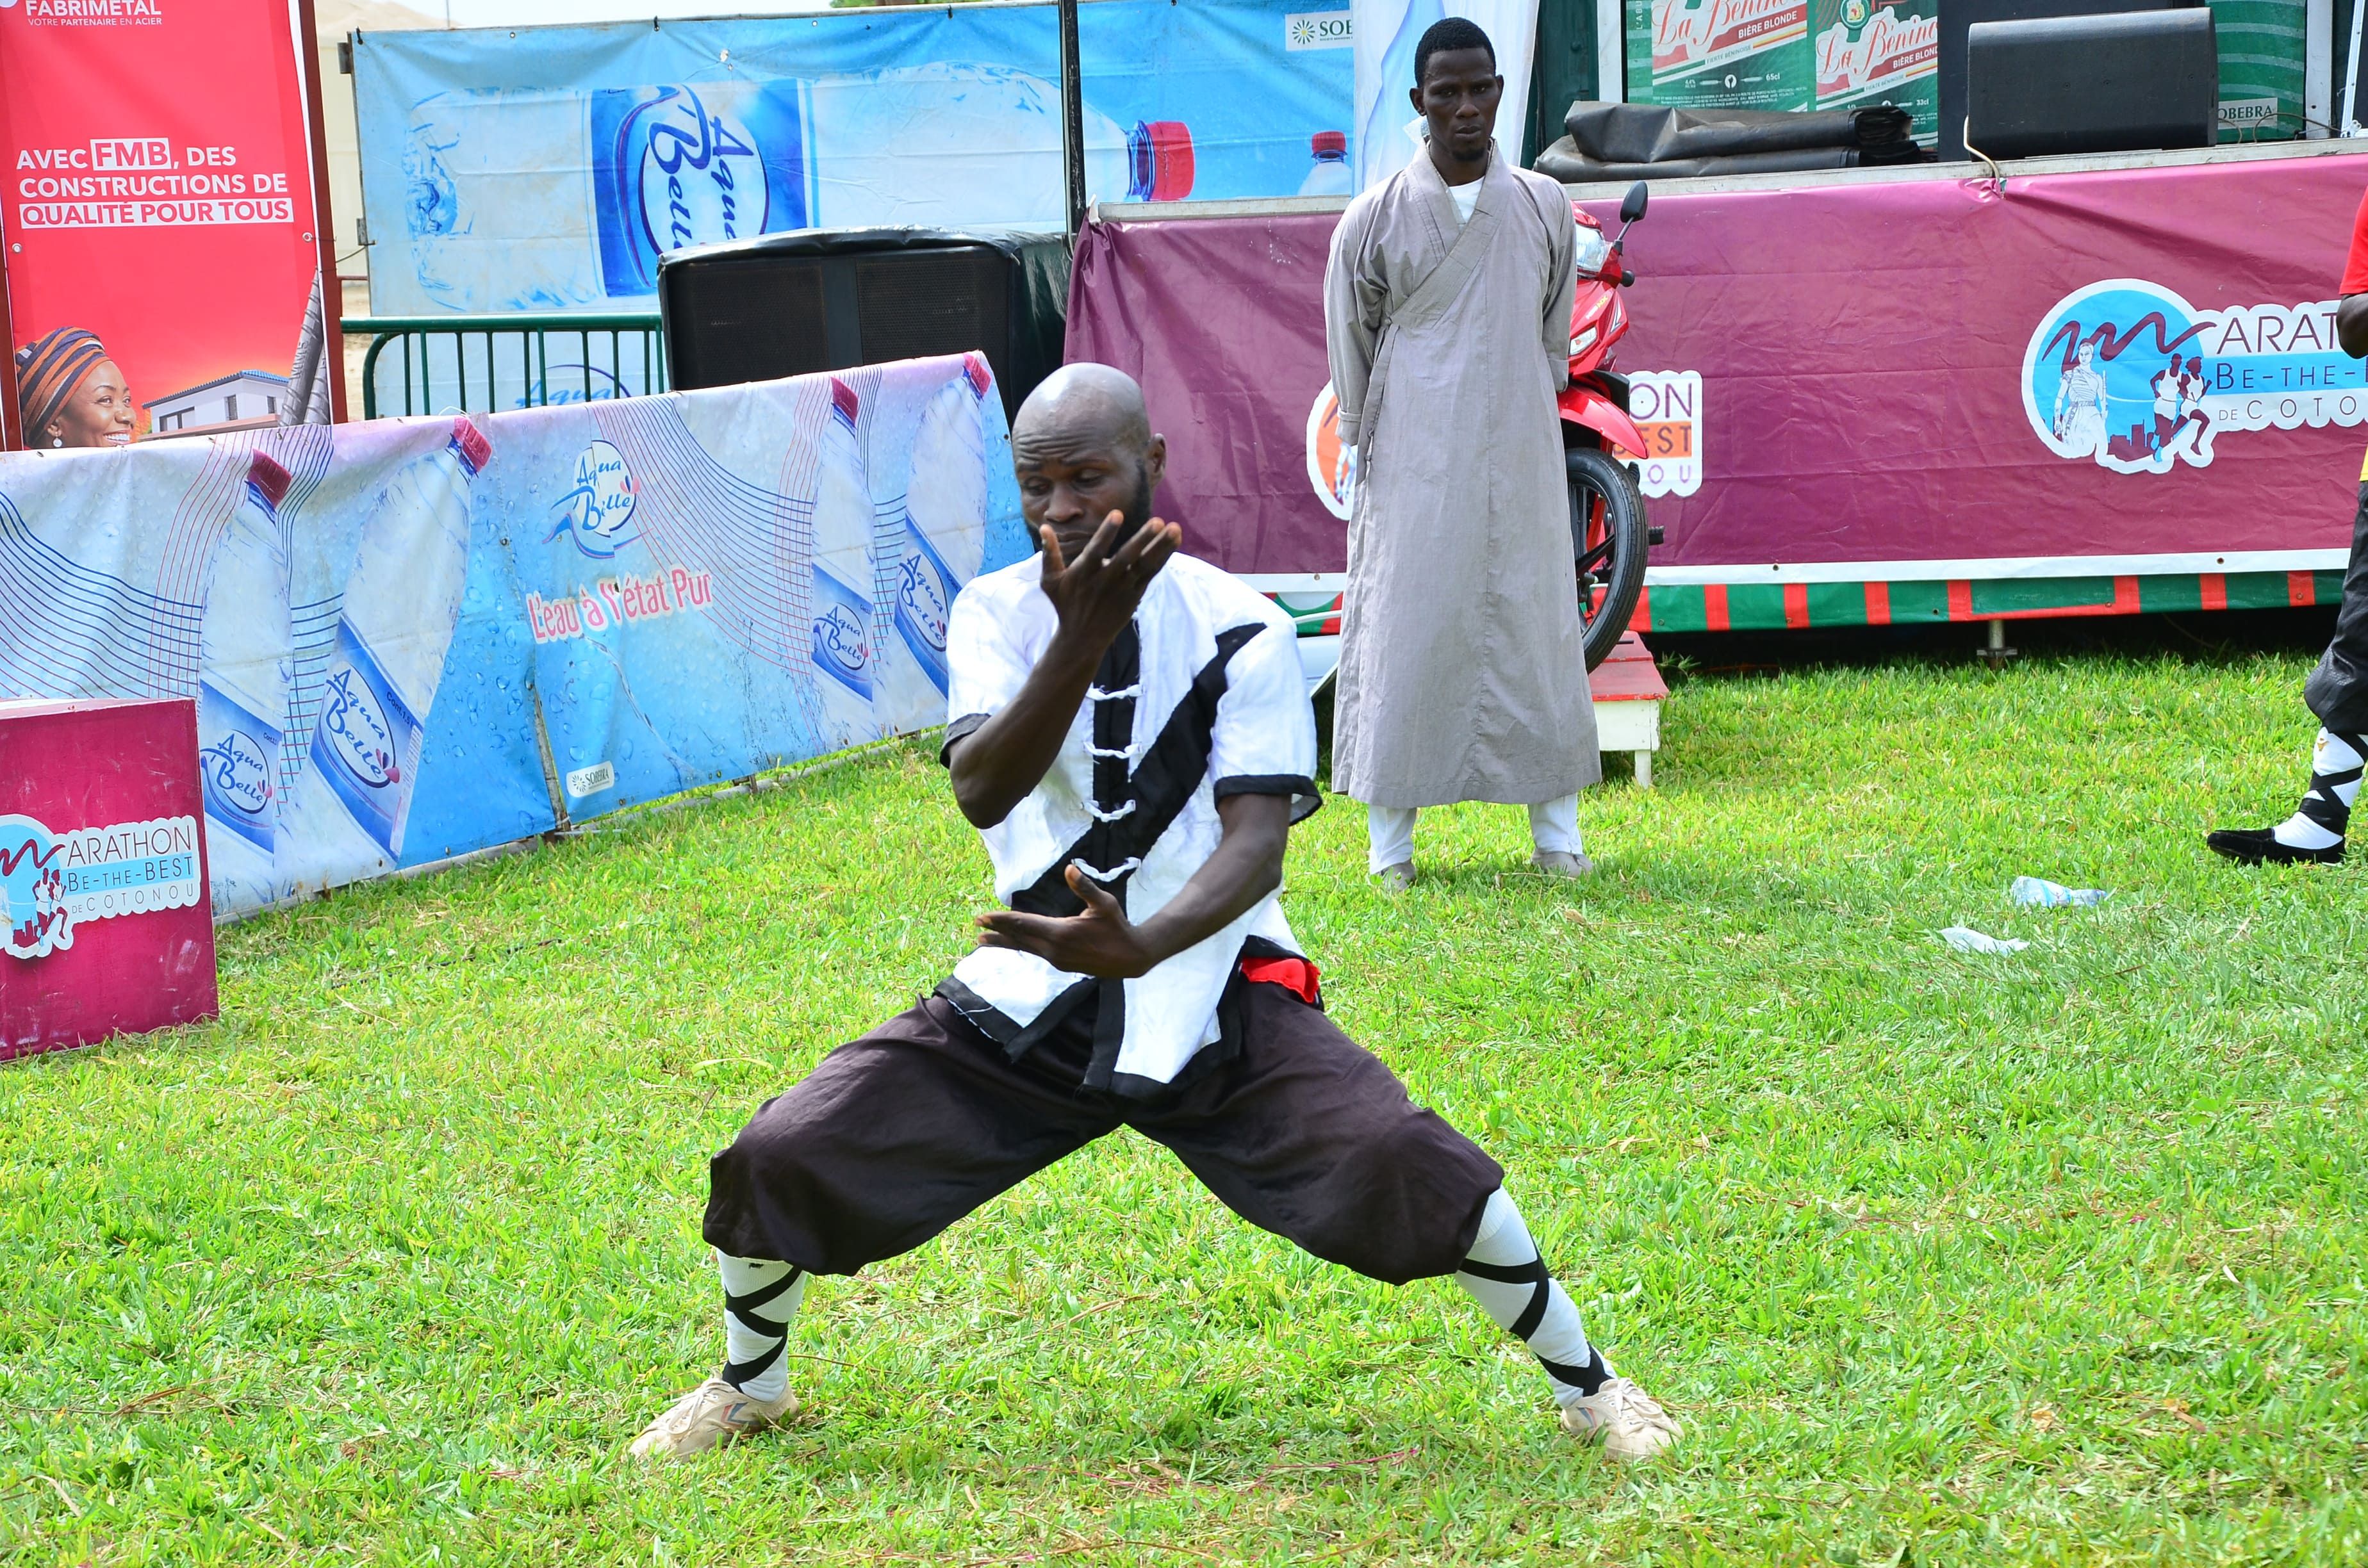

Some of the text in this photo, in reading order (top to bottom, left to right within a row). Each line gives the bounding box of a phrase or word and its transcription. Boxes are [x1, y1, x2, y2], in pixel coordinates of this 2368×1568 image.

[28, 17, 162, 26] VOTRE PARTENAIRE EN ACIER
[1738, 10, 1798, 39] BIÈRE BLONDE
[1766, 72, 1780, 81] 65cl
[1893, 56, 1914, 69] BIÈRE
[16, 149, 88, 170] AVEC
[186, 146, 236, 167] DES
[649, 84, 711, 249] Bell
[19, 173, 288, 198] CONSTRUCTIONS DE
[22, 200, 289, 225] QUALITÉ POUR TOUS
[577, 455, 621, 487] Aqua
[907, 553, 944, 614] Aqua
[528, 596, 579, 639] L'eau
[580, 589, 604, 626] à
[671, 569, 712, 607] Pur
[898, 562, 943, 644] Belle
[826, 605, 861, 637] Aqua
[814, 617, 862, 662] Belle
[333, 669, 385, 740] Aqua
[325, 679, 382, 779] Belle
[217, 733, 263, 772] Aqua
[200, 747, 263, 803] Belle
[72, 883, 193, 914] DE COTONOU
